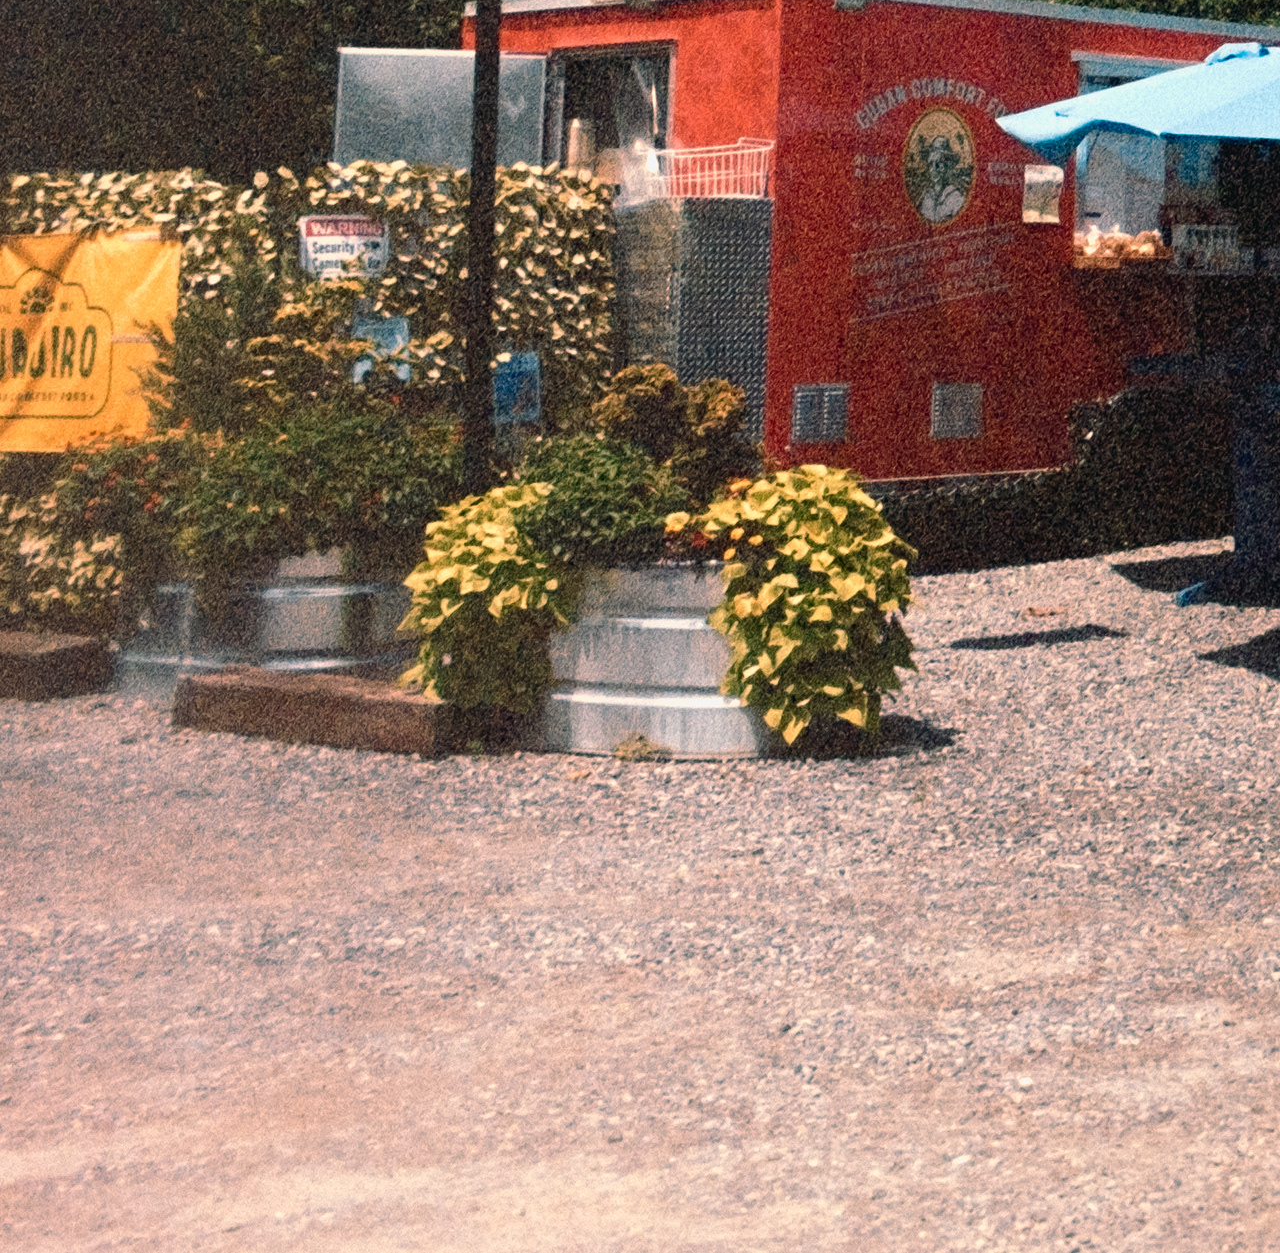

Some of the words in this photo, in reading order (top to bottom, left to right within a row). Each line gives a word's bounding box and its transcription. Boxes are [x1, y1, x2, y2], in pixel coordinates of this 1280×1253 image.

[855, 85, 907, 130] CUBAN
[910, 77, 986, 107] COMFORT
[310, 220, 383, 235] WARNING
[312, 241, 355, 255] Security
